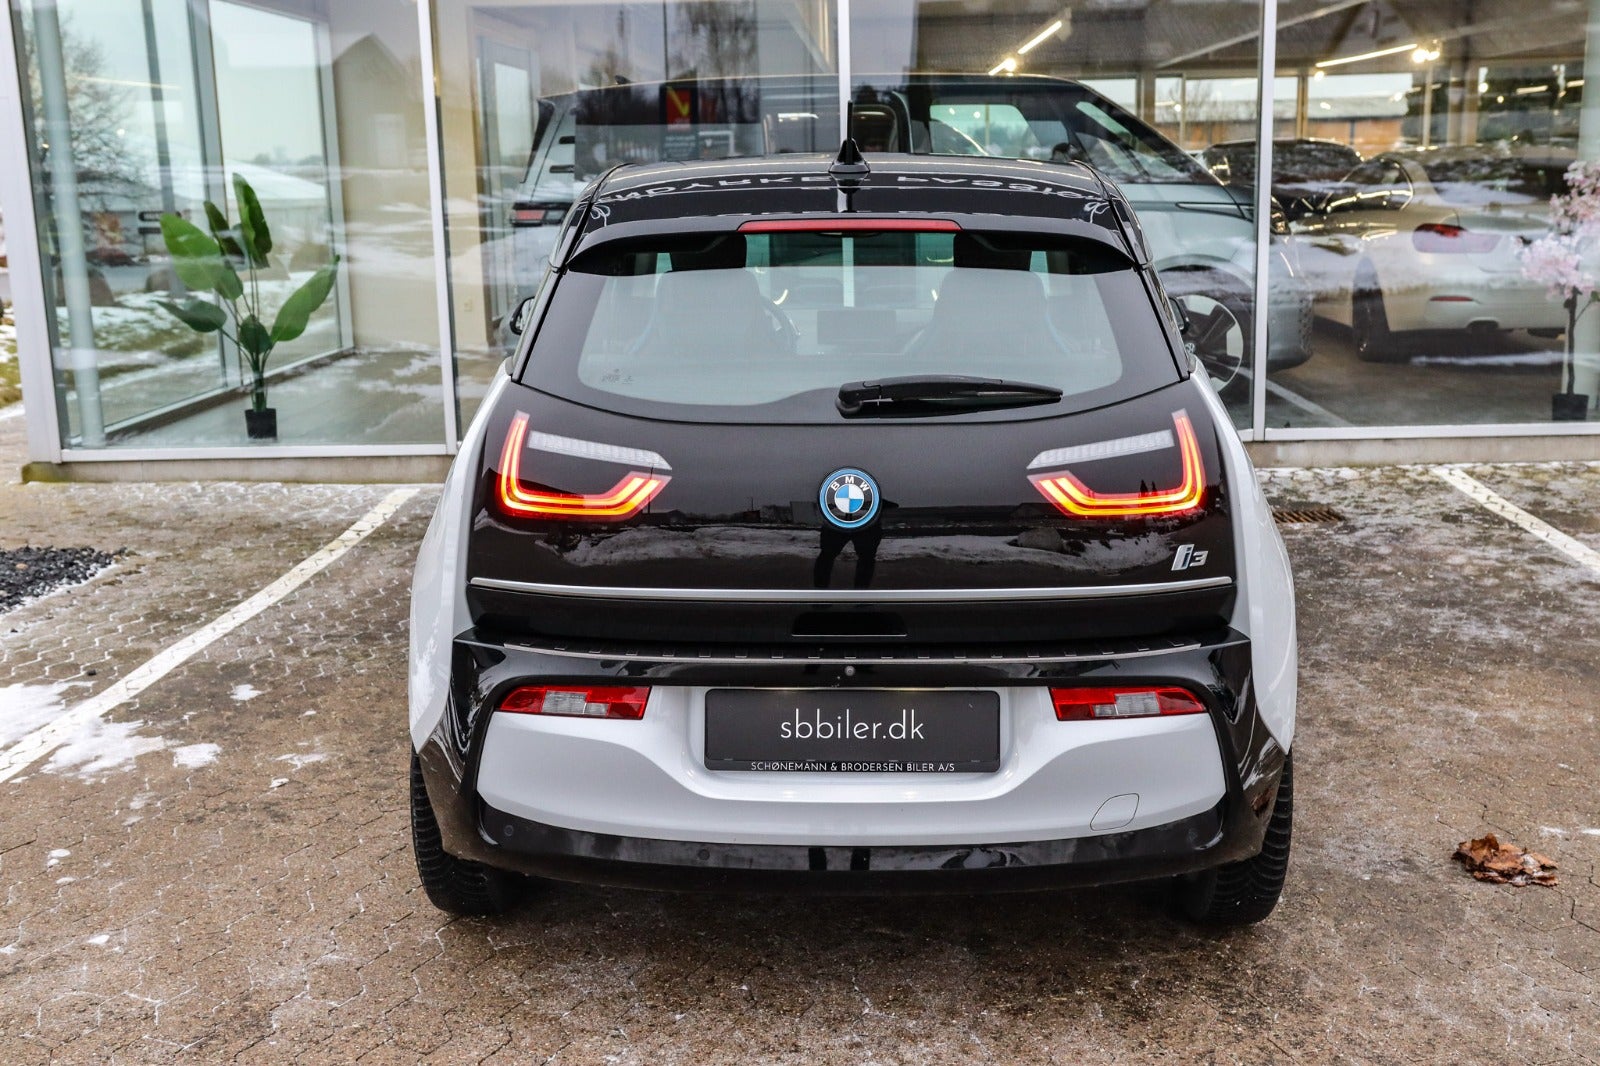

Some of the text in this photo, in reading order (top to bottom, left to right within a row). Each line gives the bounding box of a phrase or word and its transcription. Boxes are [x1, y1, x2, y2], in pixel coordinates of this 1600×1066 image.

[830, 476, 870, 492] BMW
[1171, 543, 1209, 571] i3
[780, 708, 925, 740] sbbiler.dk
[751, 761, 955, 772] SCHØNEMANN & BRODERSEN BILER A/S
